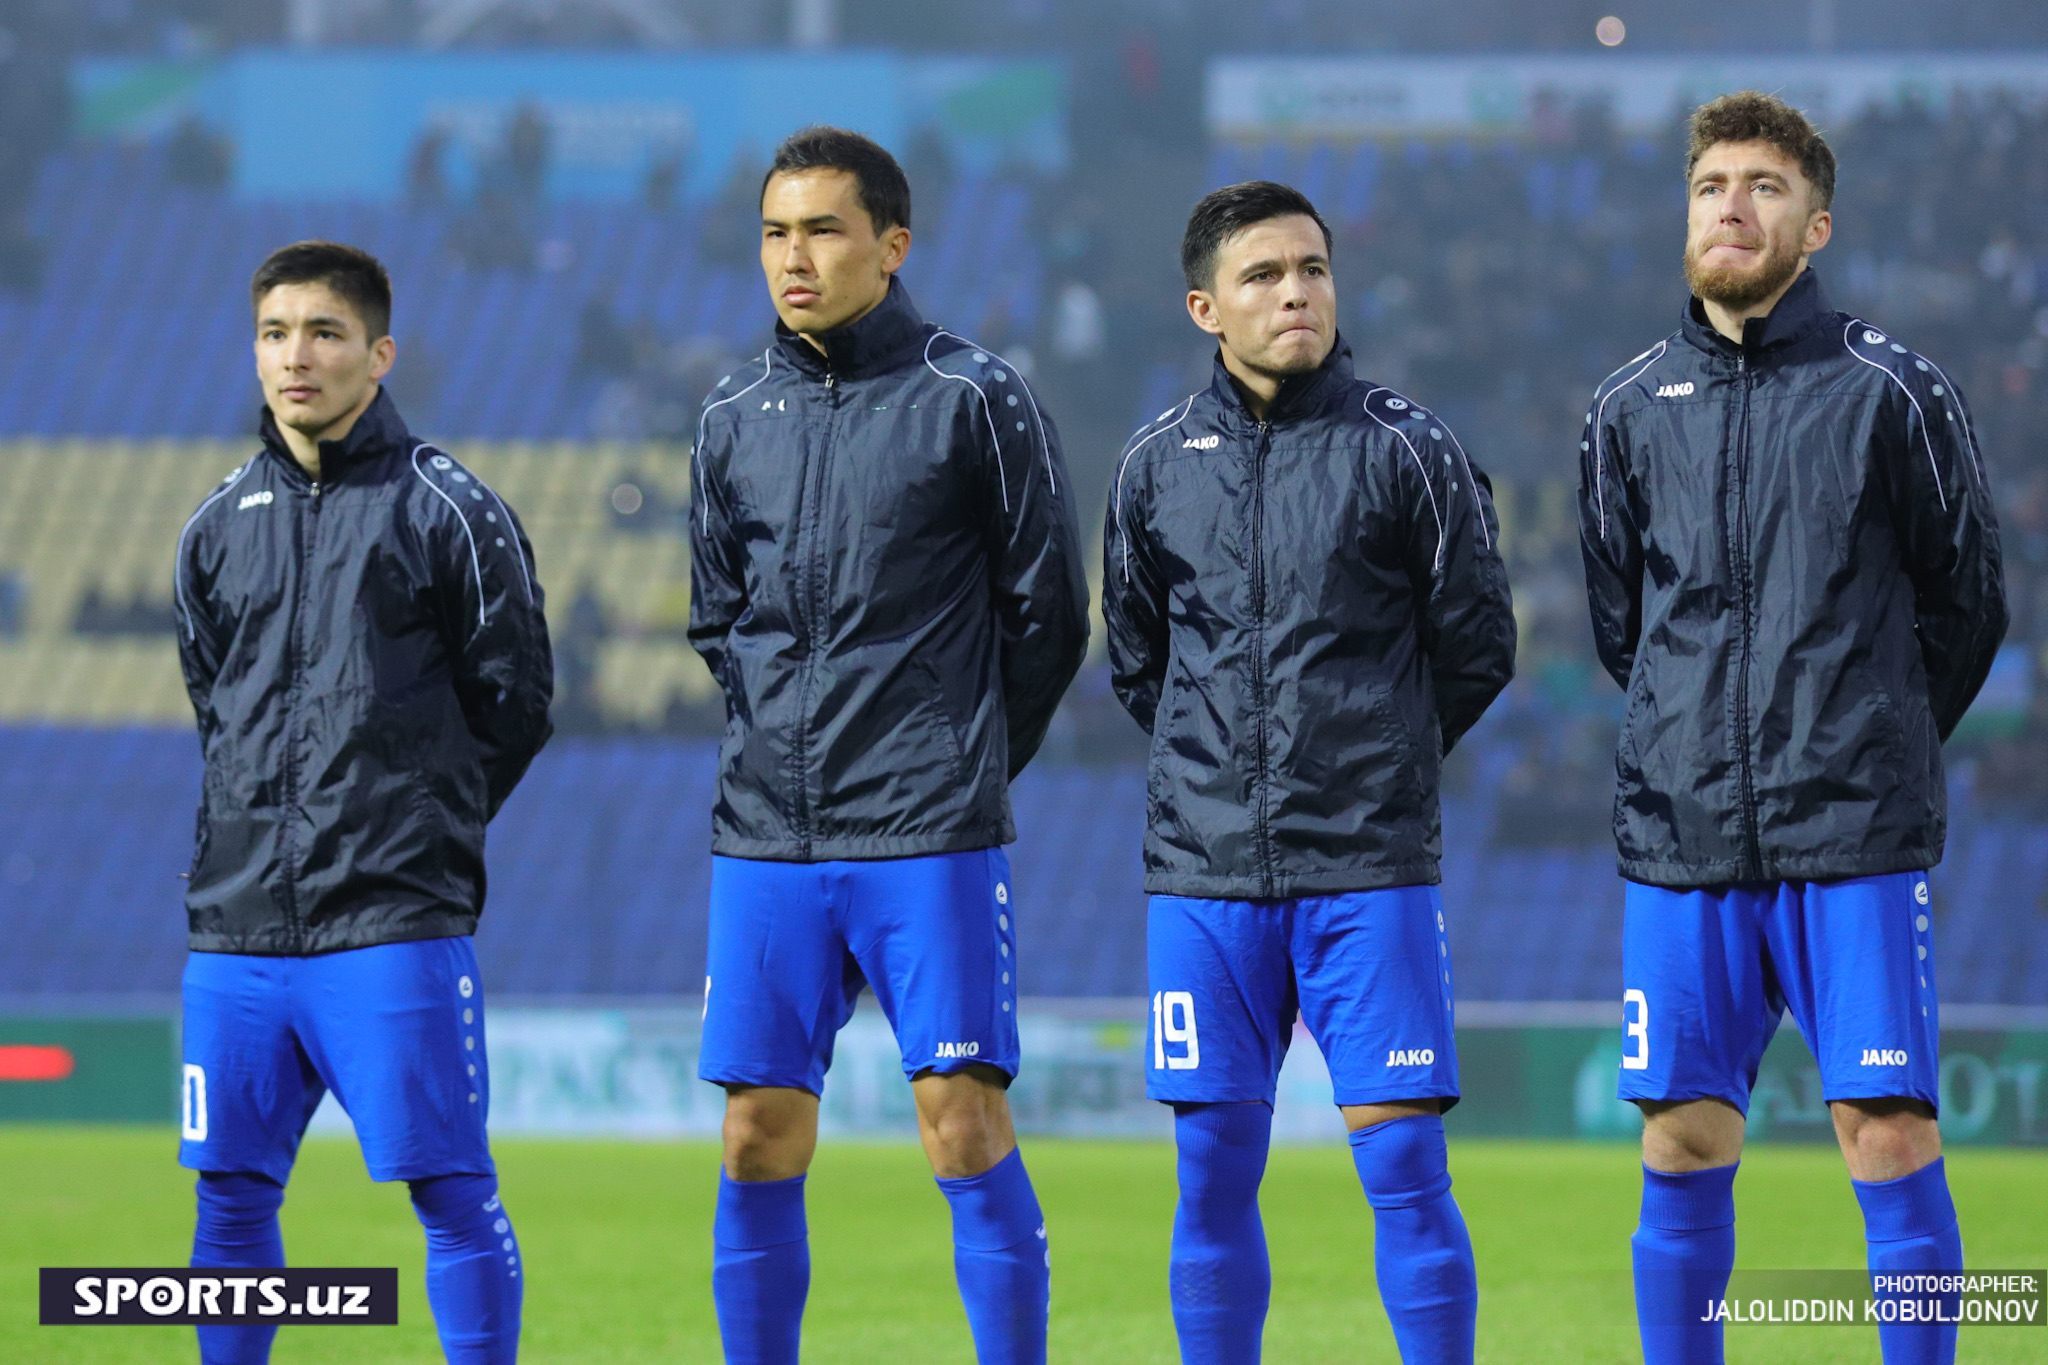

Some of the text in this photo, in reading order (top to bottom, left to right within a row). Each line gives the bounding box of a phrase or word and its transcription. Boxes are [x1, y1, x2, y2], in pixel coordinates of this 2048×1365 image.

[1655, 381, 1695, 398] JAKO
[1182, 435, 1219, 450] JAKO
[1153, 990, 1200, 1070] 19
[1619, 988, 1649, 1070] 3
[935, 1041, 980, 1058] JAKO
[1386, 1048, 1435, 1067] JAKO
[1860, 1049, 1908, 1067] JAKO
